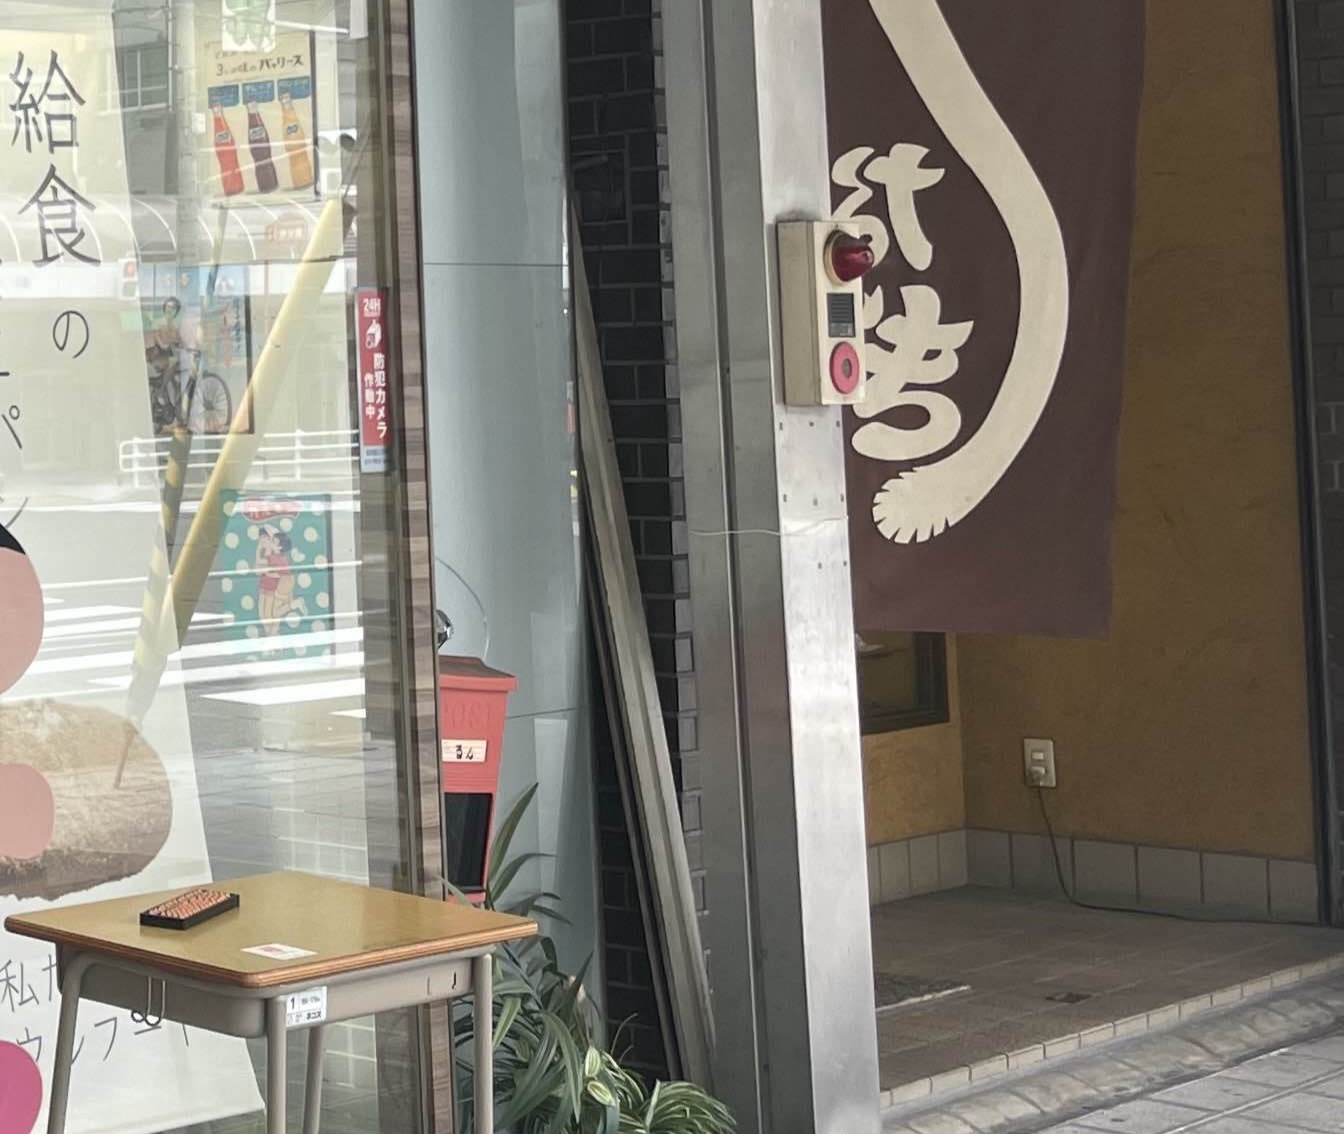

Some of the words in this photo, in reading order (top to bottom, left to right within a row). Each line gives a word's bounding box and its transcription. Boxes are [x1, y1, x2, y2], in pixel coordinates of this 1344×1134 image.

[9, 49, 103, 359] 給食の
[363, 298, 382, 312] 24H
[373, 353, 388, 440] 防犯カメラ
